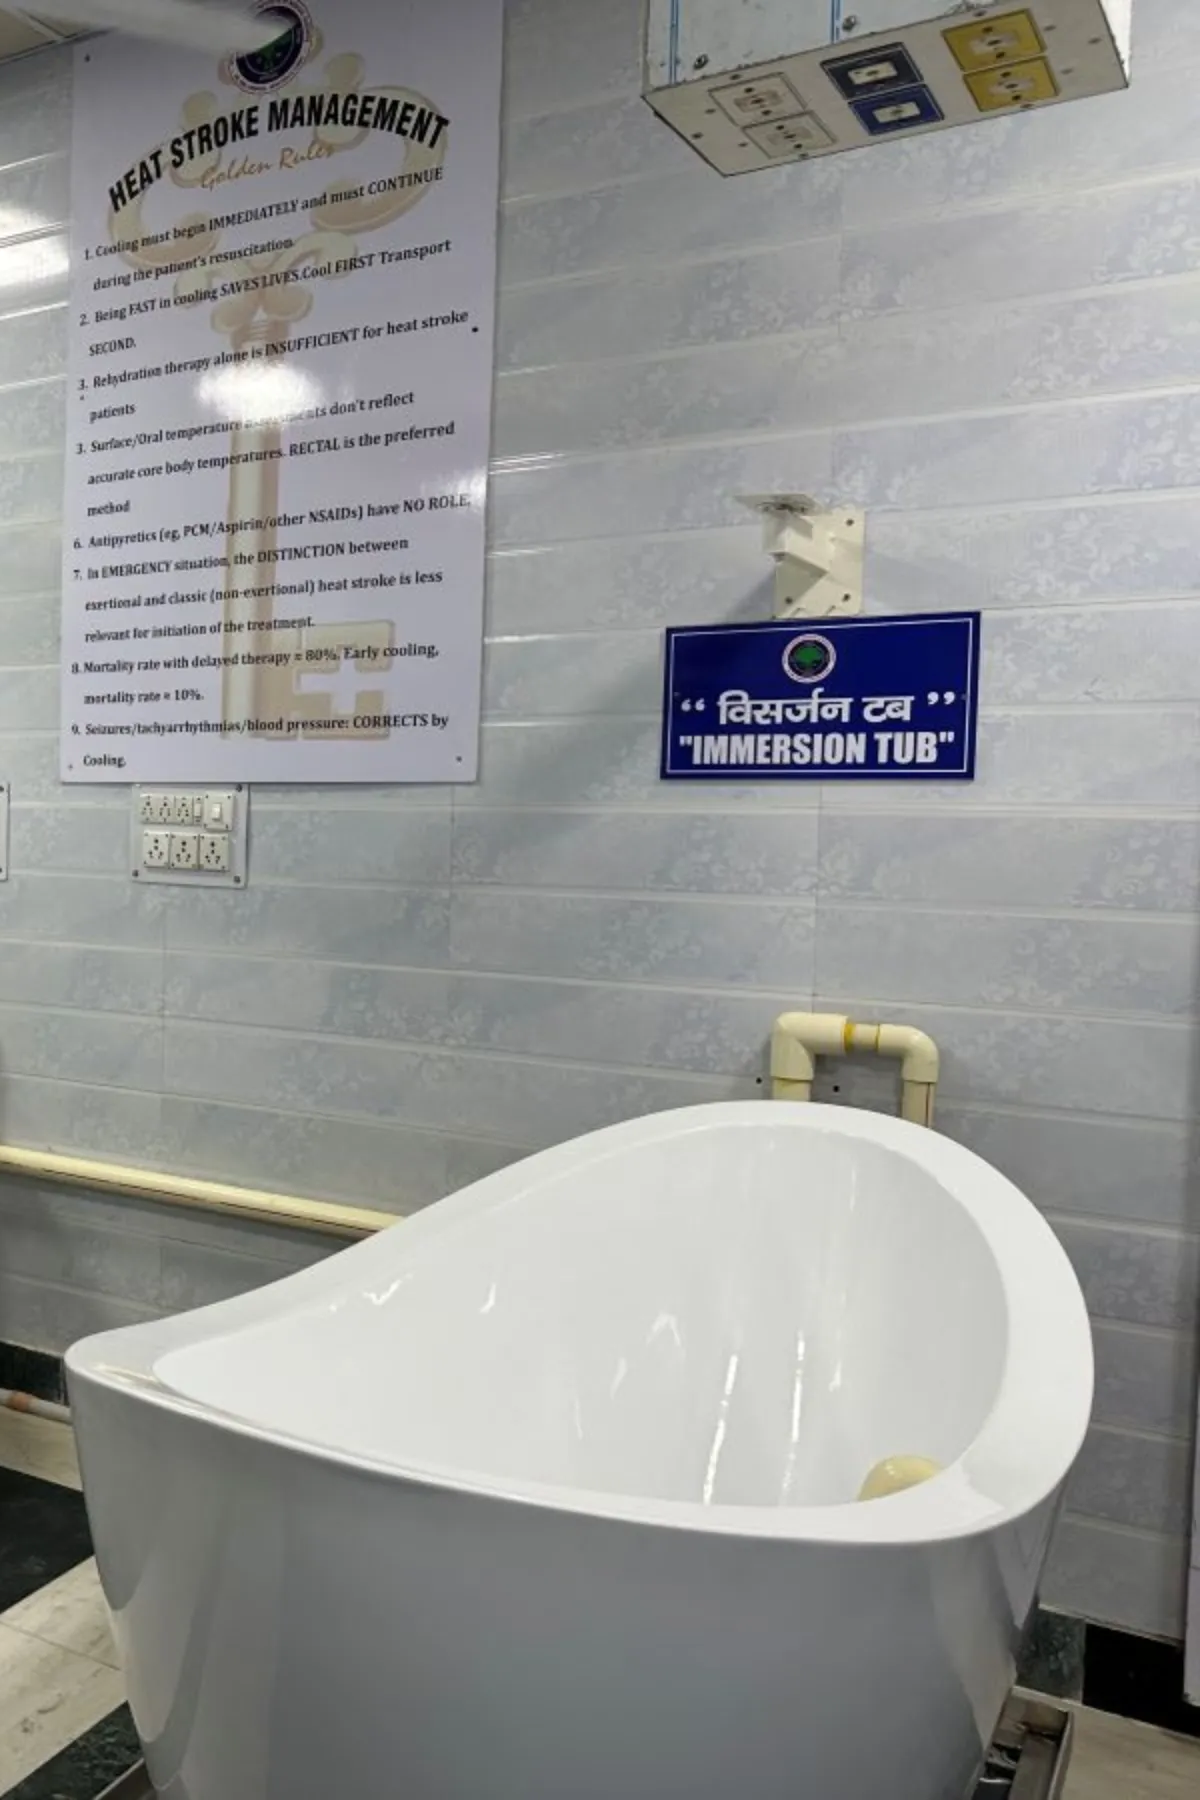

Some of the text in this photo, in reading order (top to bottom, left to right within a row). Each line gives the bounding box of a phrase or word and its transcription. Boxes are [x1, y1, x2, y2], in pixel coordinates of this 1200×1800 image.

[108, 93, 450, 213] HEAT STROKE MANAGEMENT
[95, 236, 139, 258] Cooling
[141, 231, 171, 247] must
[173, 223, 206, 240] begin
[209, 199, 298, 232] IMMEDIATELY
[301, 192, 327, 210] and
[330, 185, 365, 204] must
[367, 167, 443, 195] CONTINUE
[93, 273, 132, 291] during
[133, 265, 153, 281] the
[154, 254, 207, 280] patient's
[95, 305, 127, 323] Being
[128, 299, 157, 315] FAST
[159, 296, 171, 309] in
[173, 285, 219, 305] cooling
[219, 276, 259, 297] SAVES
[335, 254, 376, 274] FIRST
[379, 239, 452, 265] Transport
[93, 365, 162, 389] Rehydration
[164, 357, 211, 375] therapy
[213, 349, 248, 365] alone
[251, 345, 263, 359] is
[265, 327, 361, 357] INSUFFICIENT
[362, 325, 384, 340] for
[387, 318, 418, 335] heat
[421, 310, 469, 329] stroke
[89, 403, 136, 424] patients
[90, 429, 163, 453] Surface/Oral
[329, 398, 366, 416] don't
[368, 391, 414, 411] reflect
[87, 467, 136, 485] accurate
[137, 466, 163, 479] core
[165, 458, 195, 475] body
[289, 437, 341, 457] RECTAL
[343, 435, 355, 449] is
[358, 433, 381, 447] the
[383, 421, 456, 447] preferred
[87, 500, 131, 517] method
[88, 529, 157, 550] Antipyretics
[183, 513, 306, 538] PCM/Aspirin/other
[308, 505, 364, 525] NSAIDs)
[366, 503, 400, 518] have
[403, 499, 425, 514] NO
[87, 569, 99, 580] In
[101, 560, 173, 579] EMERGENCY
[233, 552, 255, 566] the
[257, 542, 345, 563] DISTINCTION
[349, 537, 409, 555] between
[85, 570, 443, 611] exertional and classic (non-exertional) heat stroke is less
[85, 628, 131, 643] relevant
[133, 627, 151, 639] for
[151, 622, 207, 638] initiation
[209, 622, 223, 634] of
[223, 620, 244, 633] the
[83, 659, 134, 675] Mortality
[137, 658, 161, 671] rate
[163, 656, 189, 669] with
[191, 653, 239, 671] delayed
[241, 651, 291, 666] therapy
[343, 645, 380, 661] Early
[83, 690, 135, 705] mortality
[138, 690, 161, 703] rate
[717, 687, 853, 725] विसर्जन
[862, 695, 915, 723] टब
[287, 717, 349, 732] pressure:
[353, 714, 428, 729] CORRECTS
[431, 713, 449, 729] by
